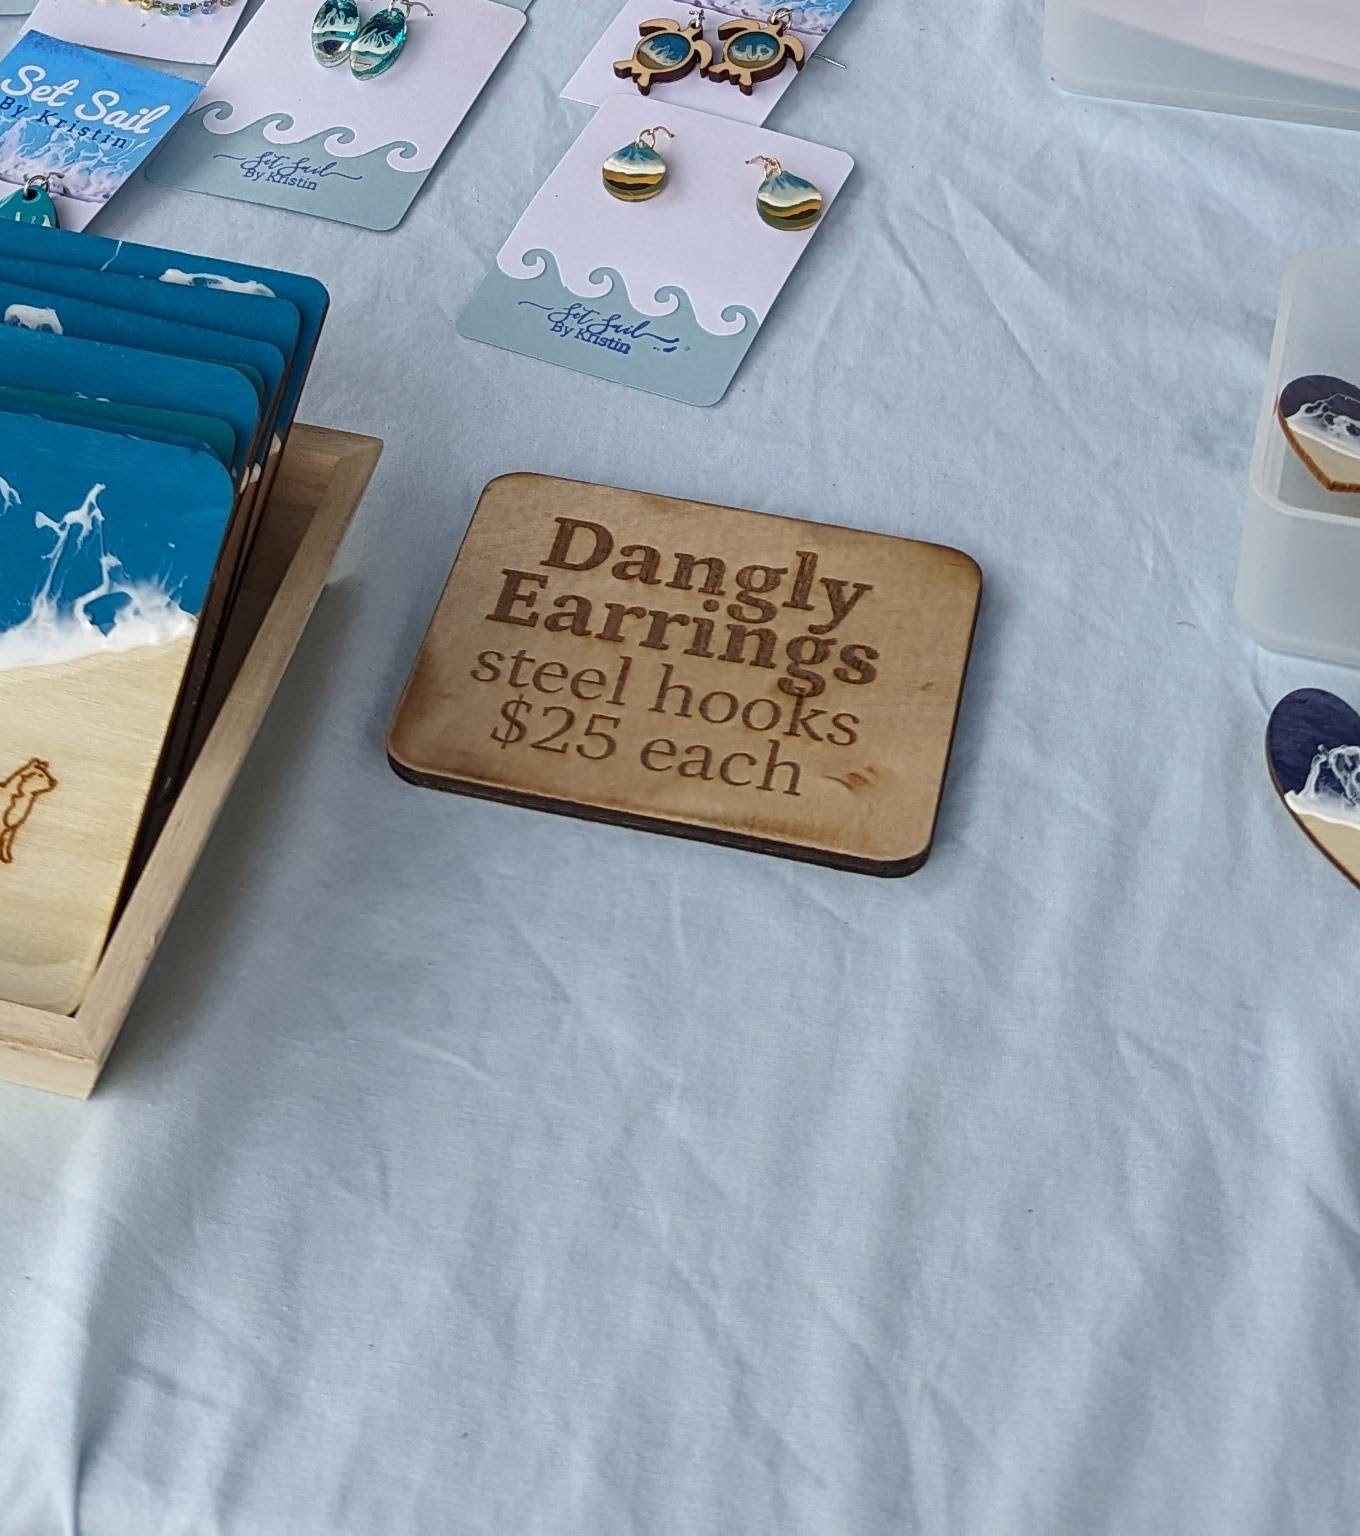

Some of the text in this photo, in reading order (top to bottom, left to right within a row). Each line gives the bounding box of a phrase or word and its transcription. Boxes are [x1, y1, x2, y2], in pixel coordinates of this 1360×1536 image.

[0, 64, 171, 134] Set Sail
[36, 109, 128, 149] Kristin
[243, 168, 318, 191] By Kristin
[551, 320, 631, 354] By Kristin
[540, 516, 874, 636] Dangly
[486, 568, 880, 699] Earrings
[471, 646, 861, 748] steel hooks
[491, 693, 803, 798] $25 each
